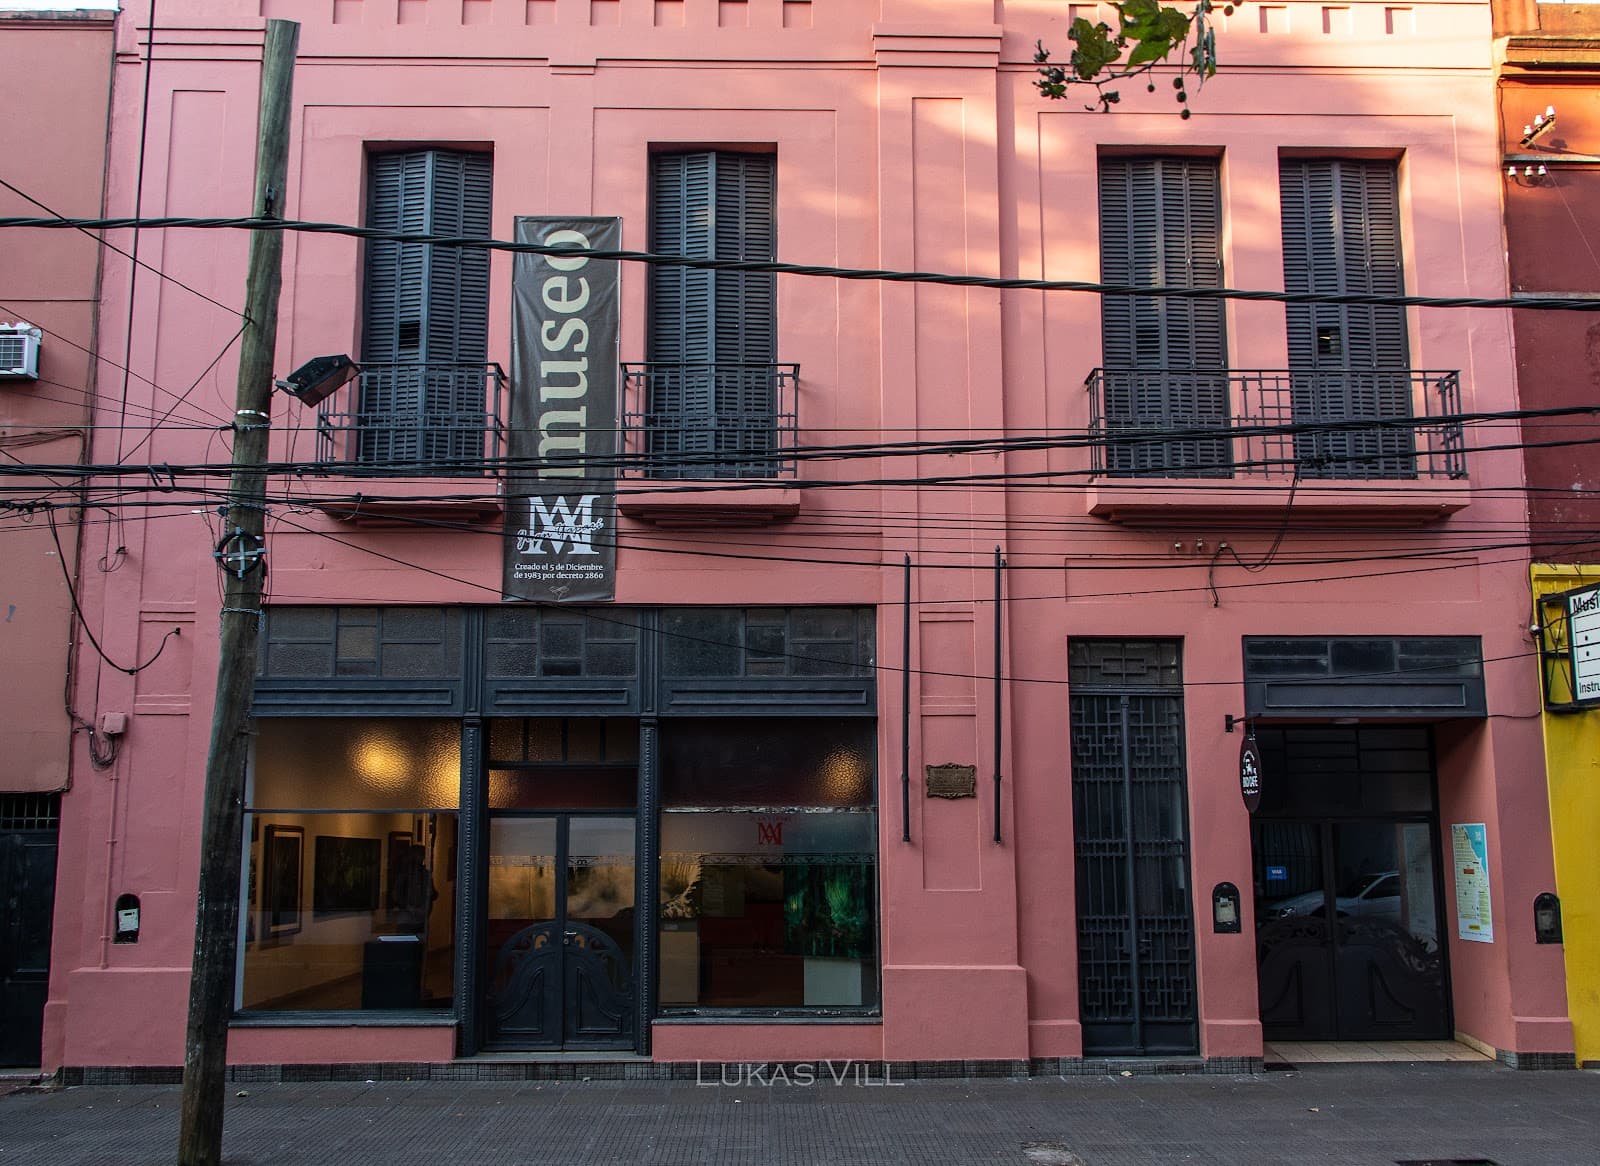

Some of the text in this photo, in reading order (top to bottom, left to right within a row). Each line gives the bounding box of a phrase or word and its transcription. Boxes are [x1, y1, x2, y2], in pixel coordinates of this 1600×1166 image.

[538, 229, 591, 481] museo
[515, 563, 604, 572] Creado el 5 de Diciembre
[524, 572, 541, 580] 1983
[556, 571, 584, 579] decreto
[584, 571, 604, 579] 2860
